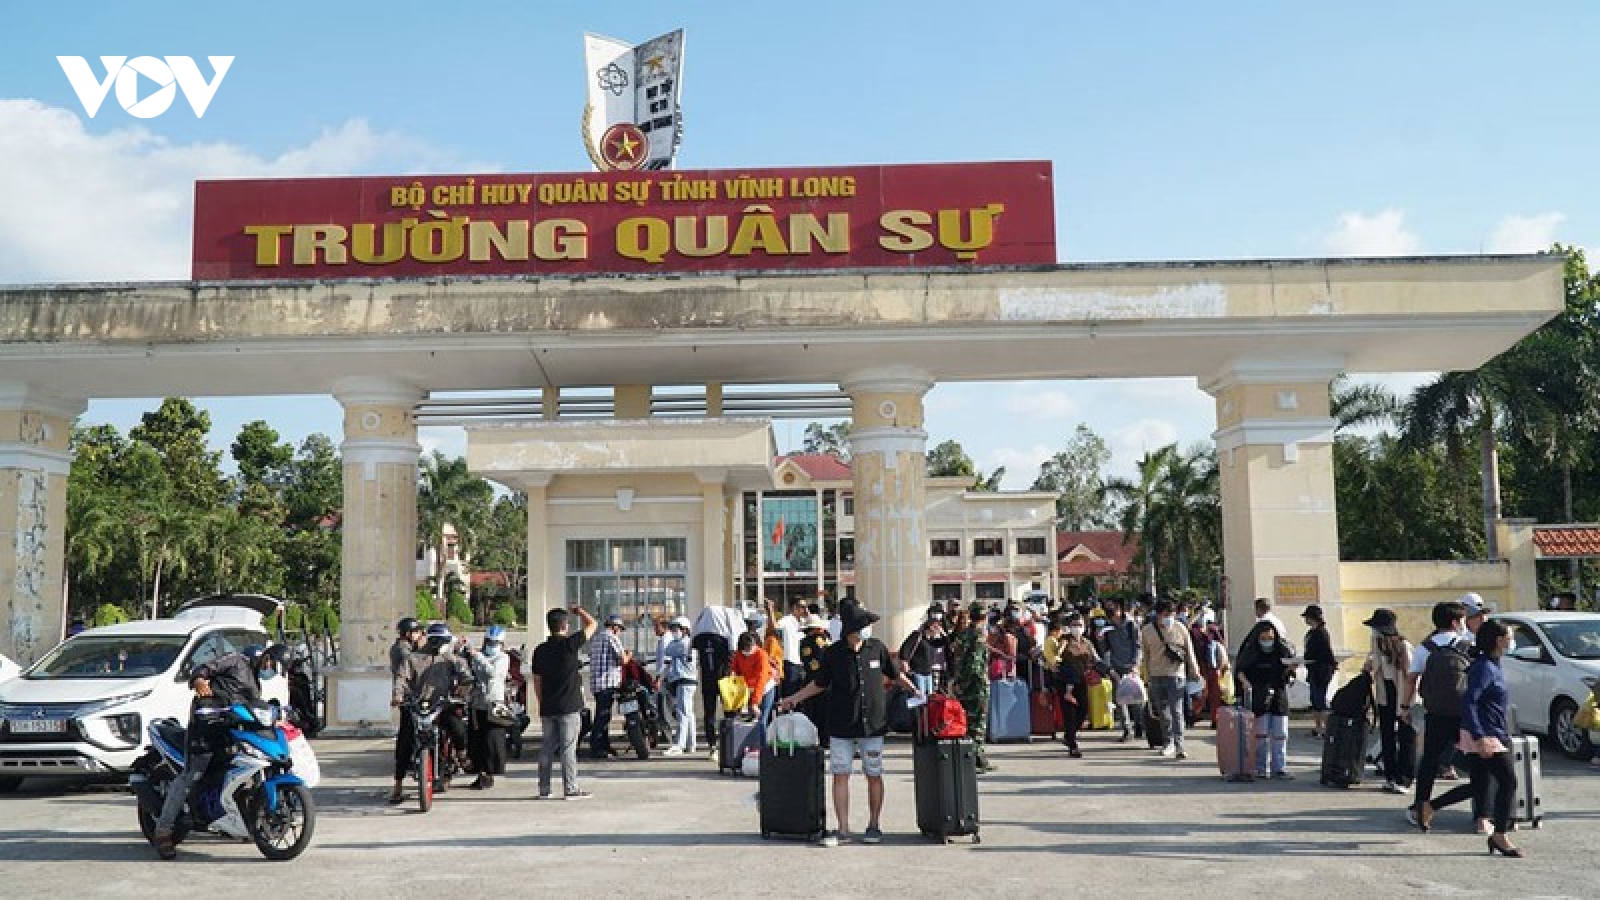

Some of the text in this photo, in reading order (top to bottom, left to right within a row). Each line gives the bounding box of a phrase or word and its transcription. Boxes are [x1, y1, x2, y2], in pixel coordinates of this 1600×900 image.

[391, 173, 857, 210] BỘ CHỈ HUY QUÂN SỰ TỈNH VĨNH LONG
[243, 202, 1005, 265] TRƯỜNG QUÂN SỰ
